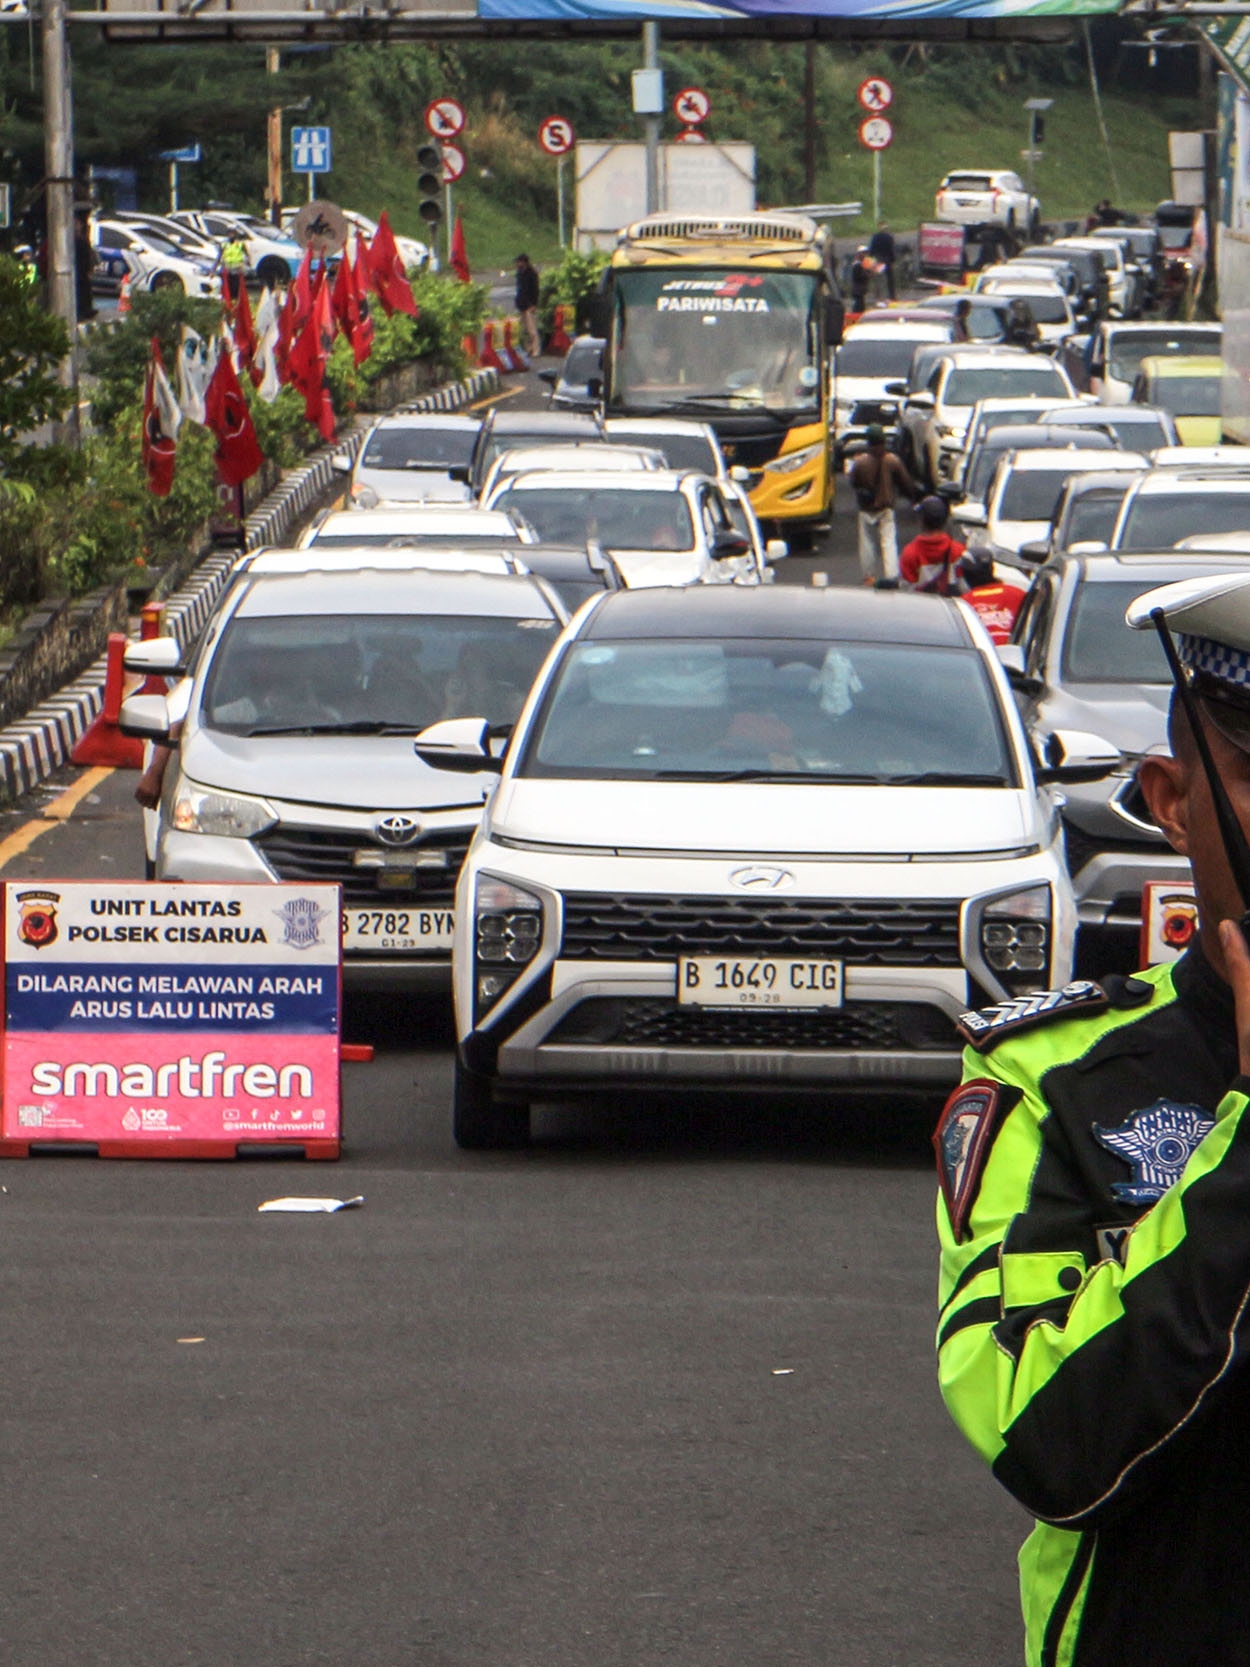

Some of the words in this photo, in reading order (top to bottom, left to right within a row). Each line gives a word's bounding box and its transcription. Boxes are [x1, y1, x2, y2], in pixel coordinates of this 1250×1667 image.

[657, 296, 770, 312] PARIWISATA
[90, 899, 145, 916] UNIT
[150, 900, 241, 917] LANTAS
[358, 912, 409, 935] 2782
[68, 925, 158, 943] POLSEK
[164, 926, 267, 943] CISARUA
[17, 975, 132, 993] DILARANG
[139, 976, 252, 994] MELAWAN
[258, 978, 323, 995] ARAH
[686, 962, 700, 988] B
[715, 962, 777, 988] 1649
[790, 964, 836, 990] CIG
[70, 1001, 132, 1018] ARUS
[137, 1001, 193, 1018] LALU
[198, 1002, 275, 1019] LINTAS
[31, 1051, 313, 1098] smartfren
